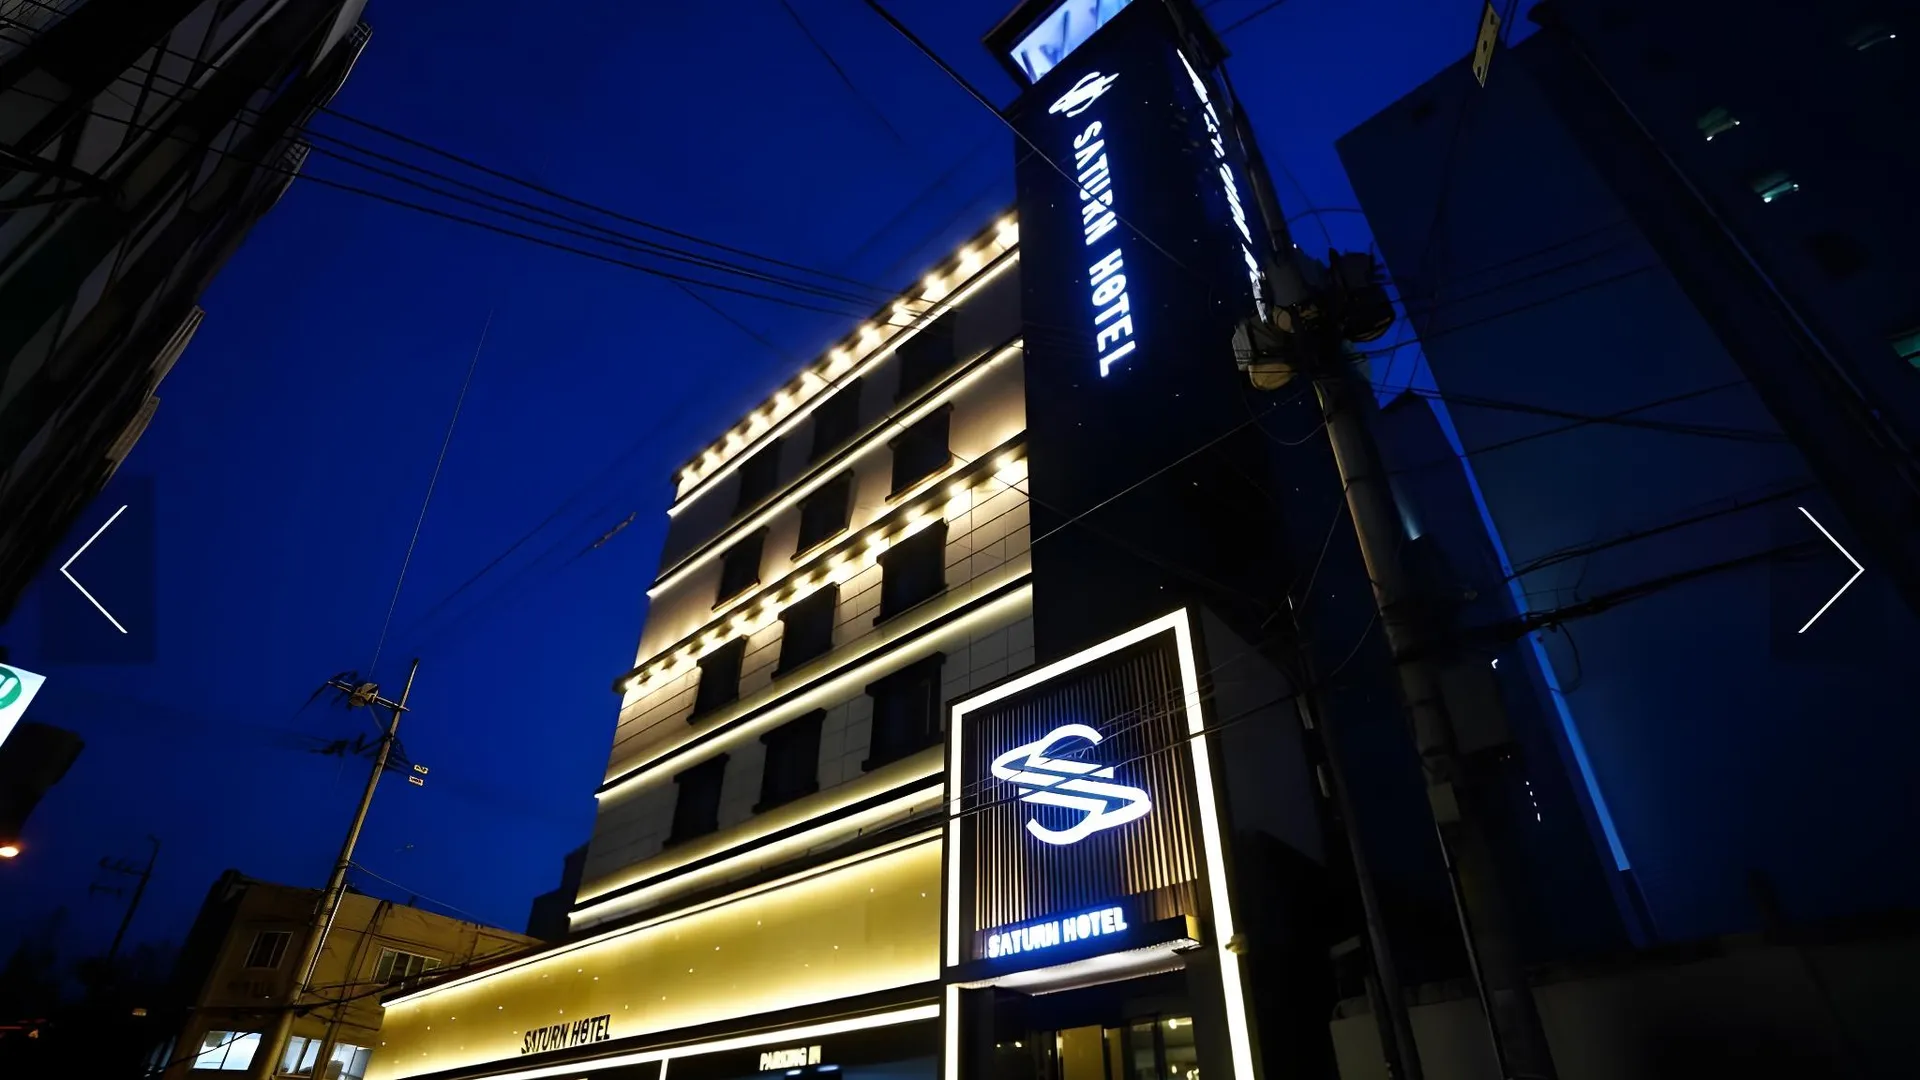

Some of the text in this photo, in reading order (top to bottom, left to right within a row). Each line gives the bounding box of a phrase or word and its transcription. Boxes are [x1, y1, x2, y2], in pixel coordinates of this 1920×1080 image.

[1073, 120, 1136, 378] SATURN HOTEL
[988, 906, 1128, 959] SATURN HOTEL
[521, 1014, 611, 1054] SATURN HOTEL
